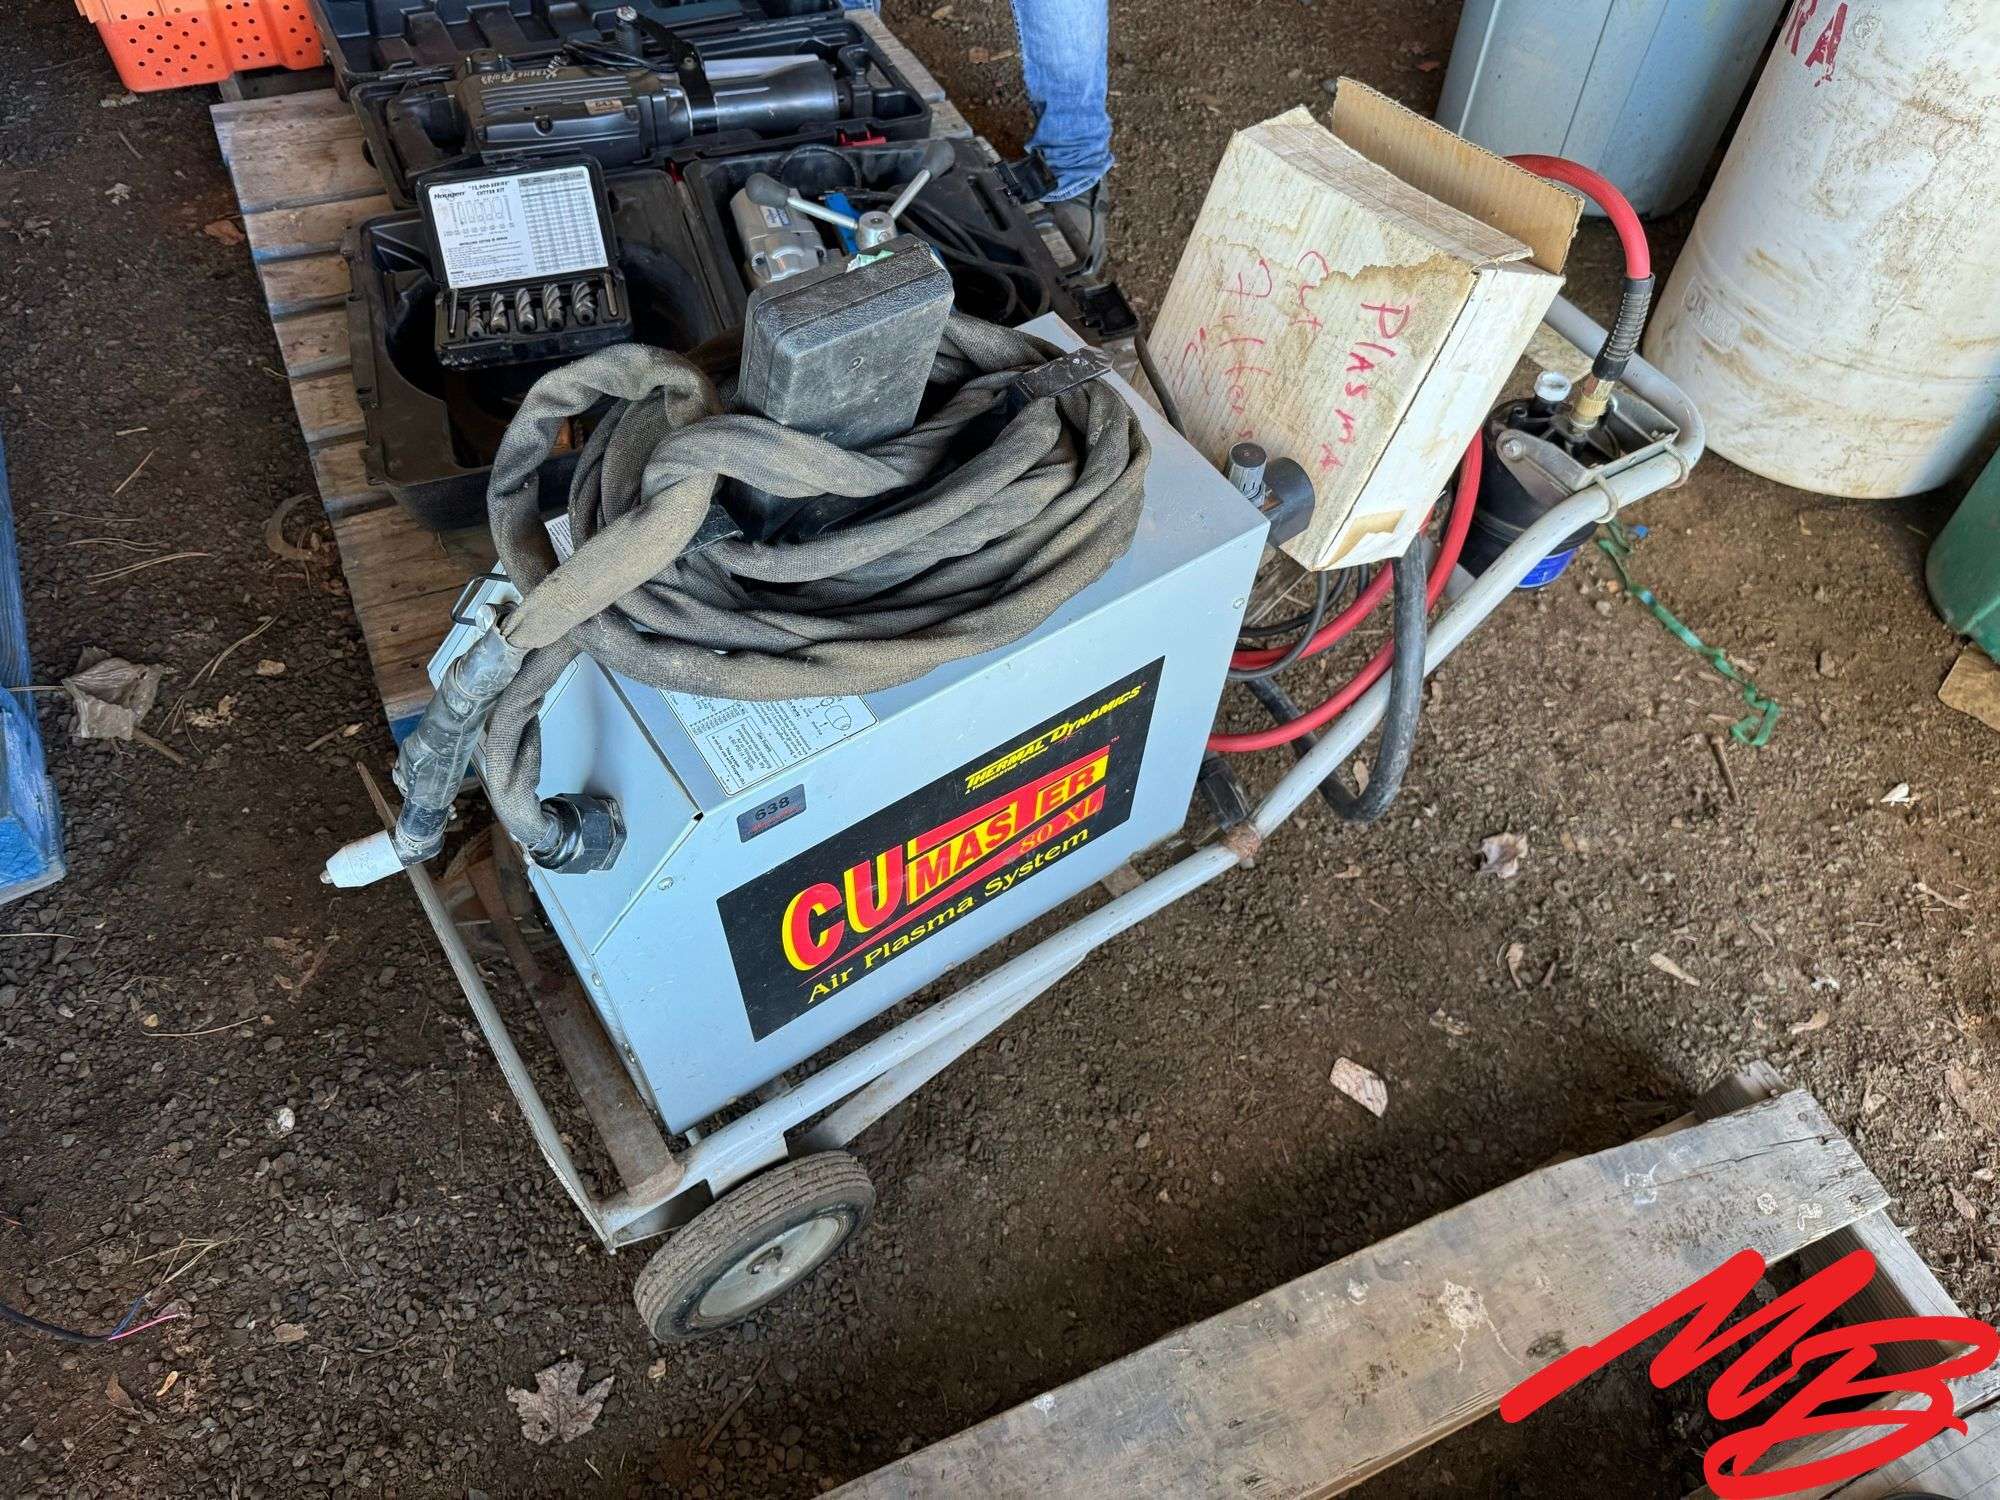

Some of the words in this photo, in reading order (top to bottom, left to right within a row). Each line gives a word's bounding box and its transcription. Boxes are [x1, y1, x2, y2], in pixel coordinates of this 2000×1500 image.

[1051, 686, 1142, 743] DYNAMICS
[754, 797, 790, 821] 638
[1061, 788, 1103, 829] XL
[807, 966, 854, 1004] Air
[863, 895, 974, 970] Plasma
[984, 828, 1089, 897] System
